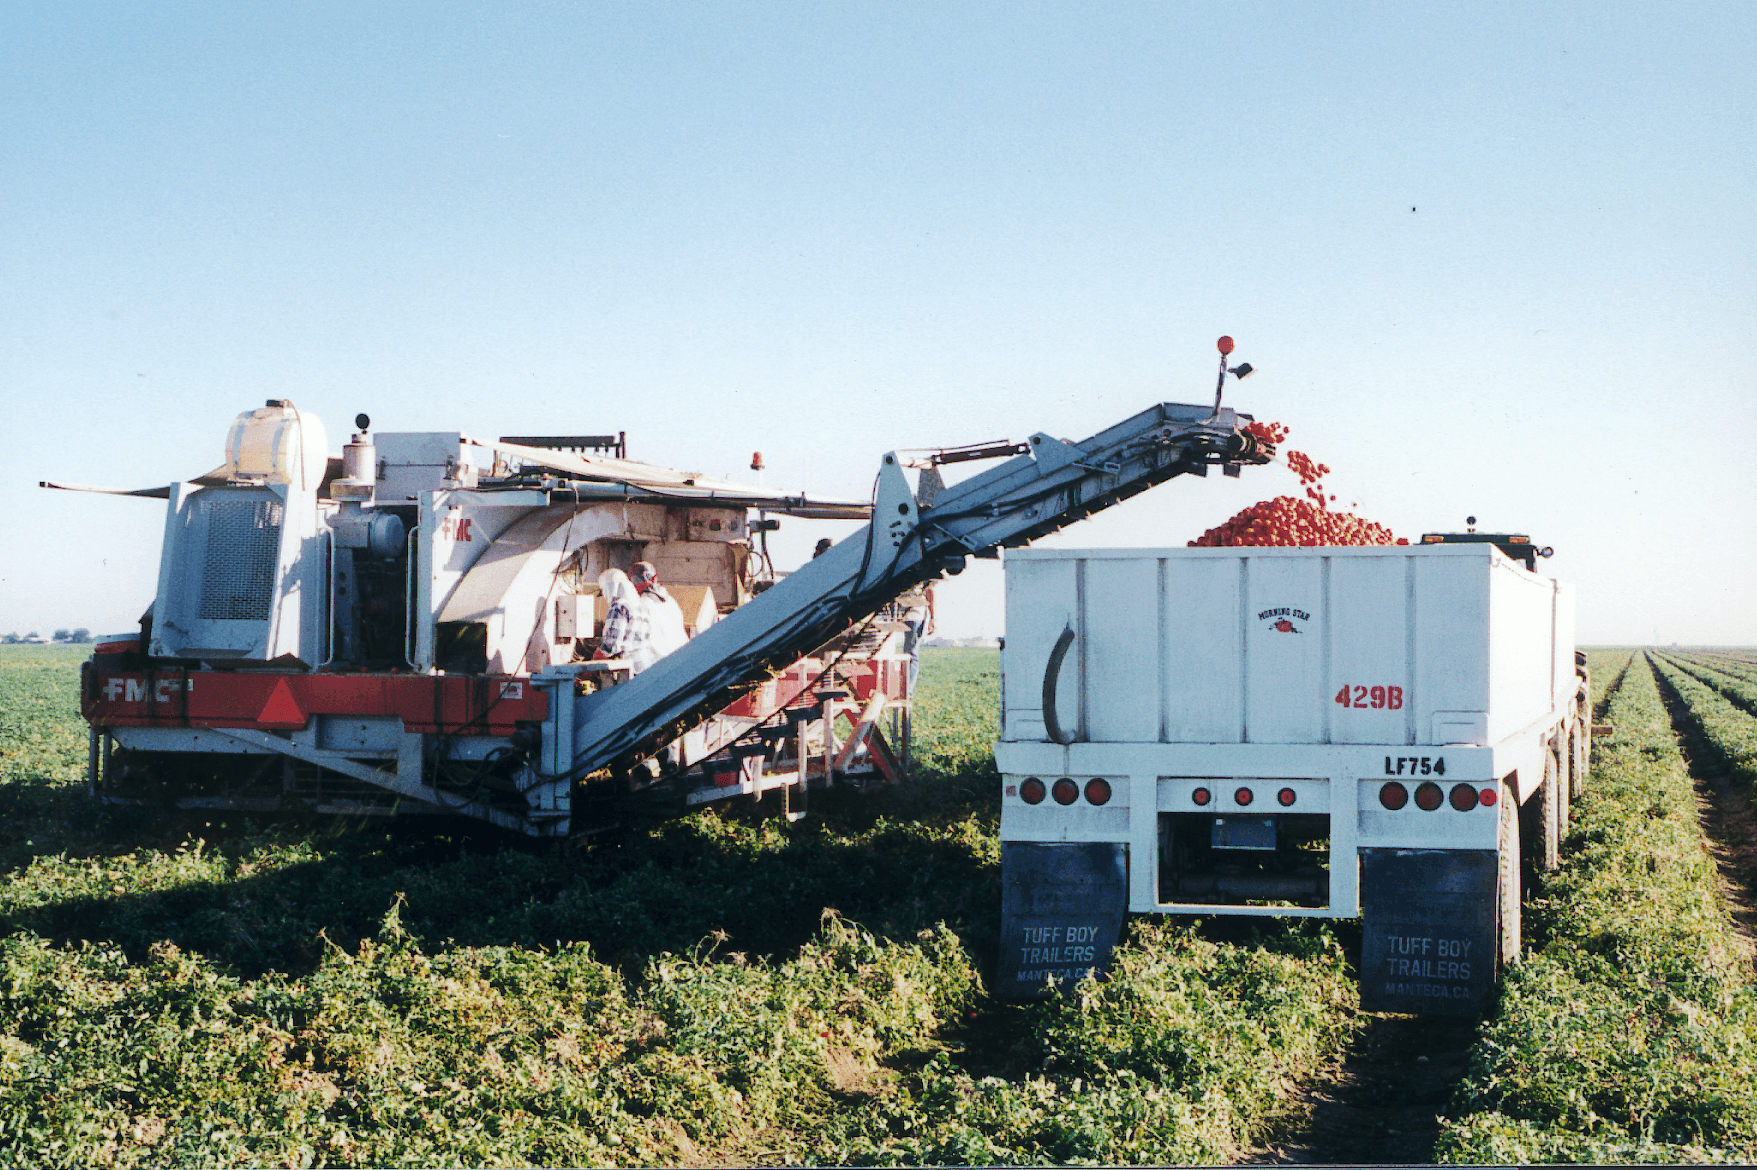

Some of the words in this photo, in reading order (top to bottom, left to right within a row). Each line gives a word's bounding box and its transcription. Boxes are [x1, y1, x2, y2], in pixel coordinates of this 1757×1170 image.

[442, 517, 472, 541] FMC
[1258, 608, 1290, 620] MORNING
[1293, 609, 1310, 620] STAR
[103, 678, 169, 703] FMC
[1335, 684, 1403, 710] 429B
[1385, 757, 1445, 776] LF754
[1023, 927, 1062, 944] TUFF
[1066, 926, 1098, 943] BOY
[1021, 945, 1095, 964] TRAILERS
[1388, 936, 1432, 955] TUFF
[1438, 939, 1472, 957] BOY
[1386, 958, 1471, 979] TRAILERS
